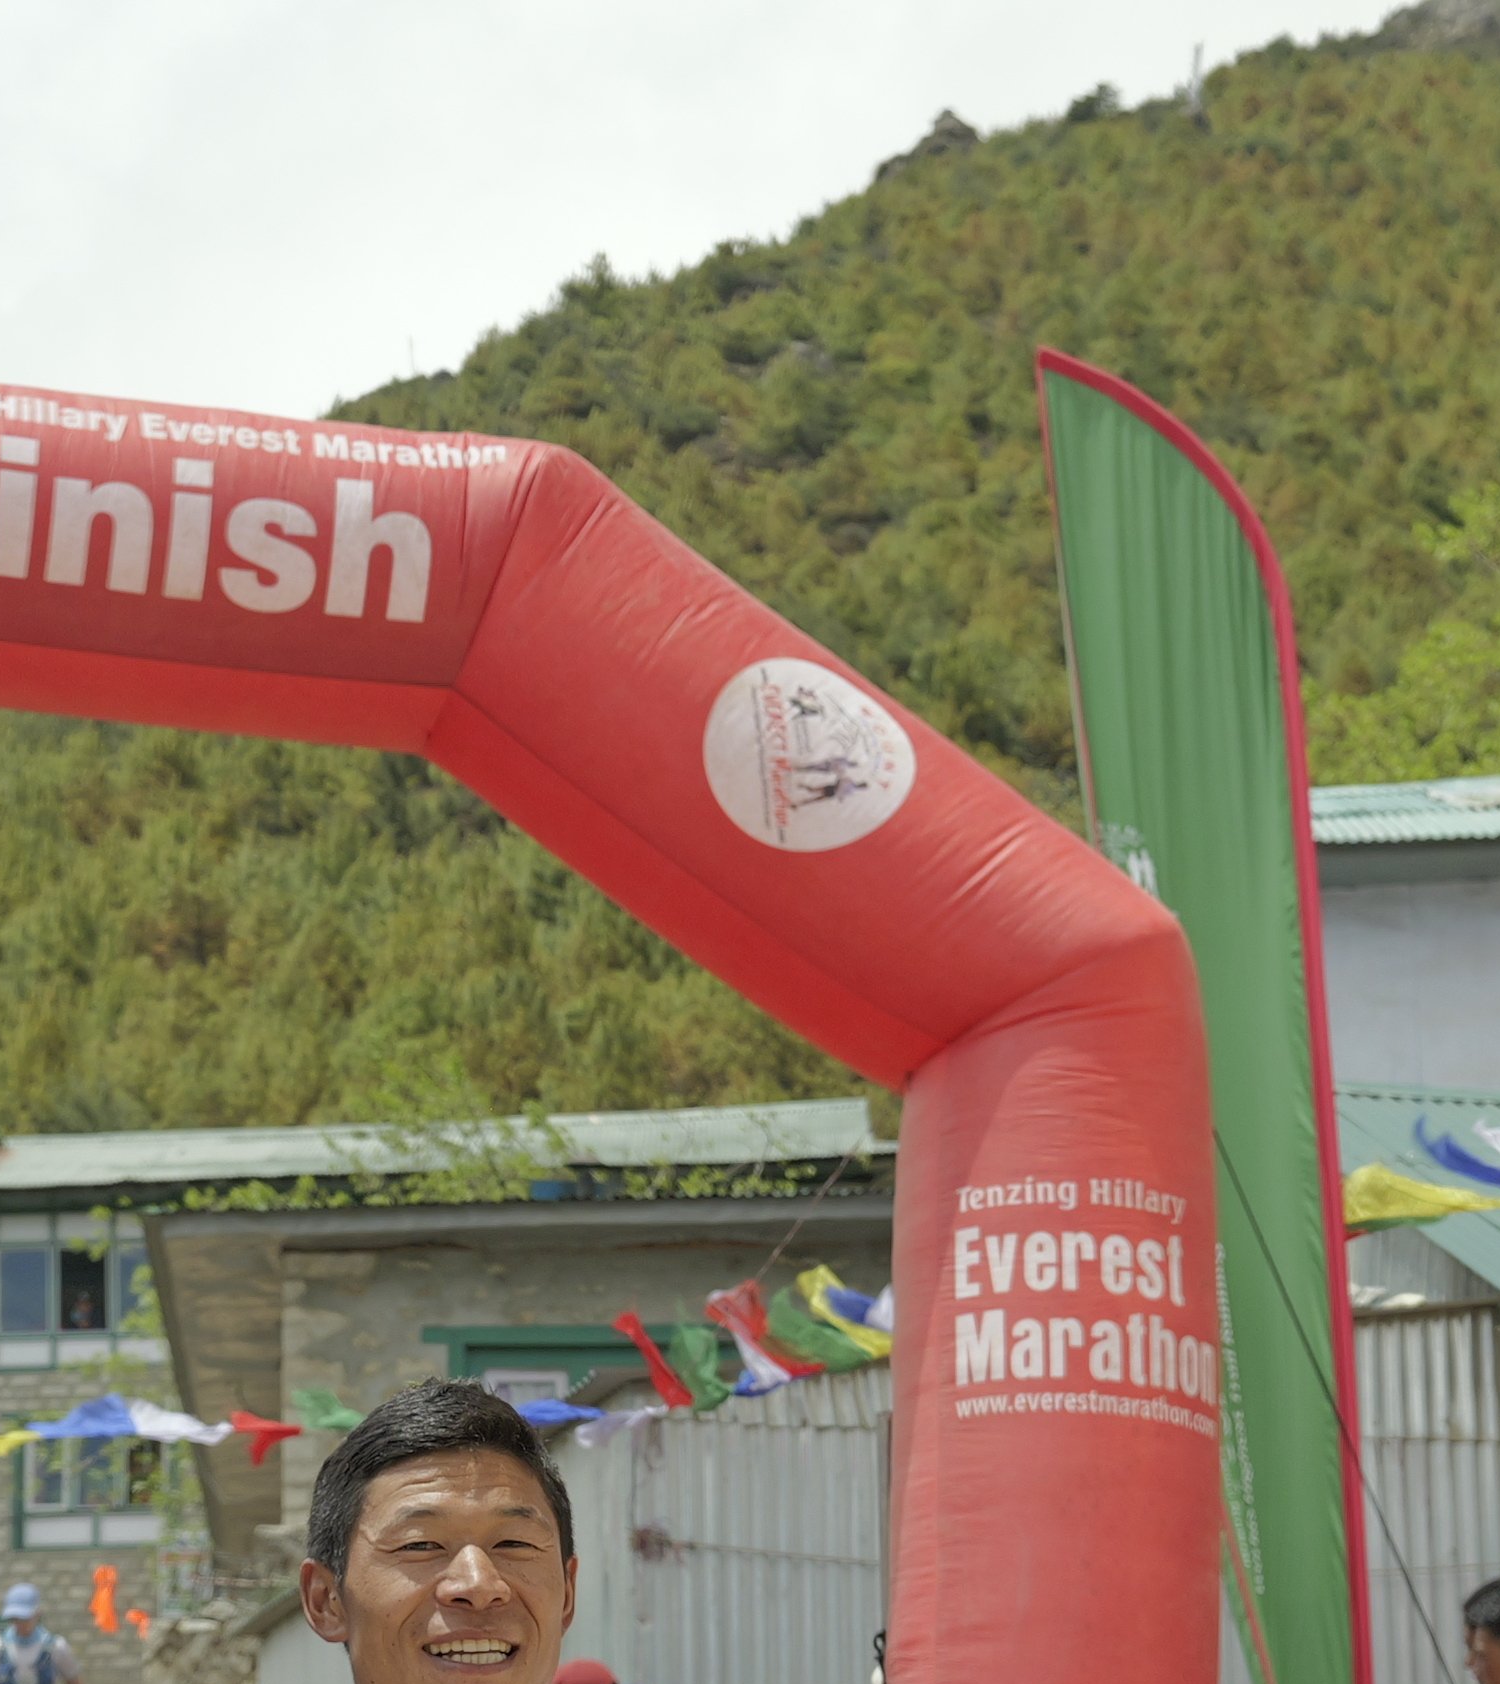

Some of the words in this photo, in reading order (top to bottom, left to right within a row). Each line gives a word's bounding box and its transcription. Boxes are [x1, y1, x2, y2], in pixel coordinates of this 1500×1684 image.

[139, 411, 302, 457] Everest
[313, 434, 508, 470] Marathon
[956, 1175, 1078, 1214] Tenzing
[1088, 1177, 1187, 1225] Hillary
[954, 1224, 1186, 1308] Everest
[954, 1308, 1219, 1407] Marathon
[955, 1389, 1219, 1440] www.everestmarathon.com
